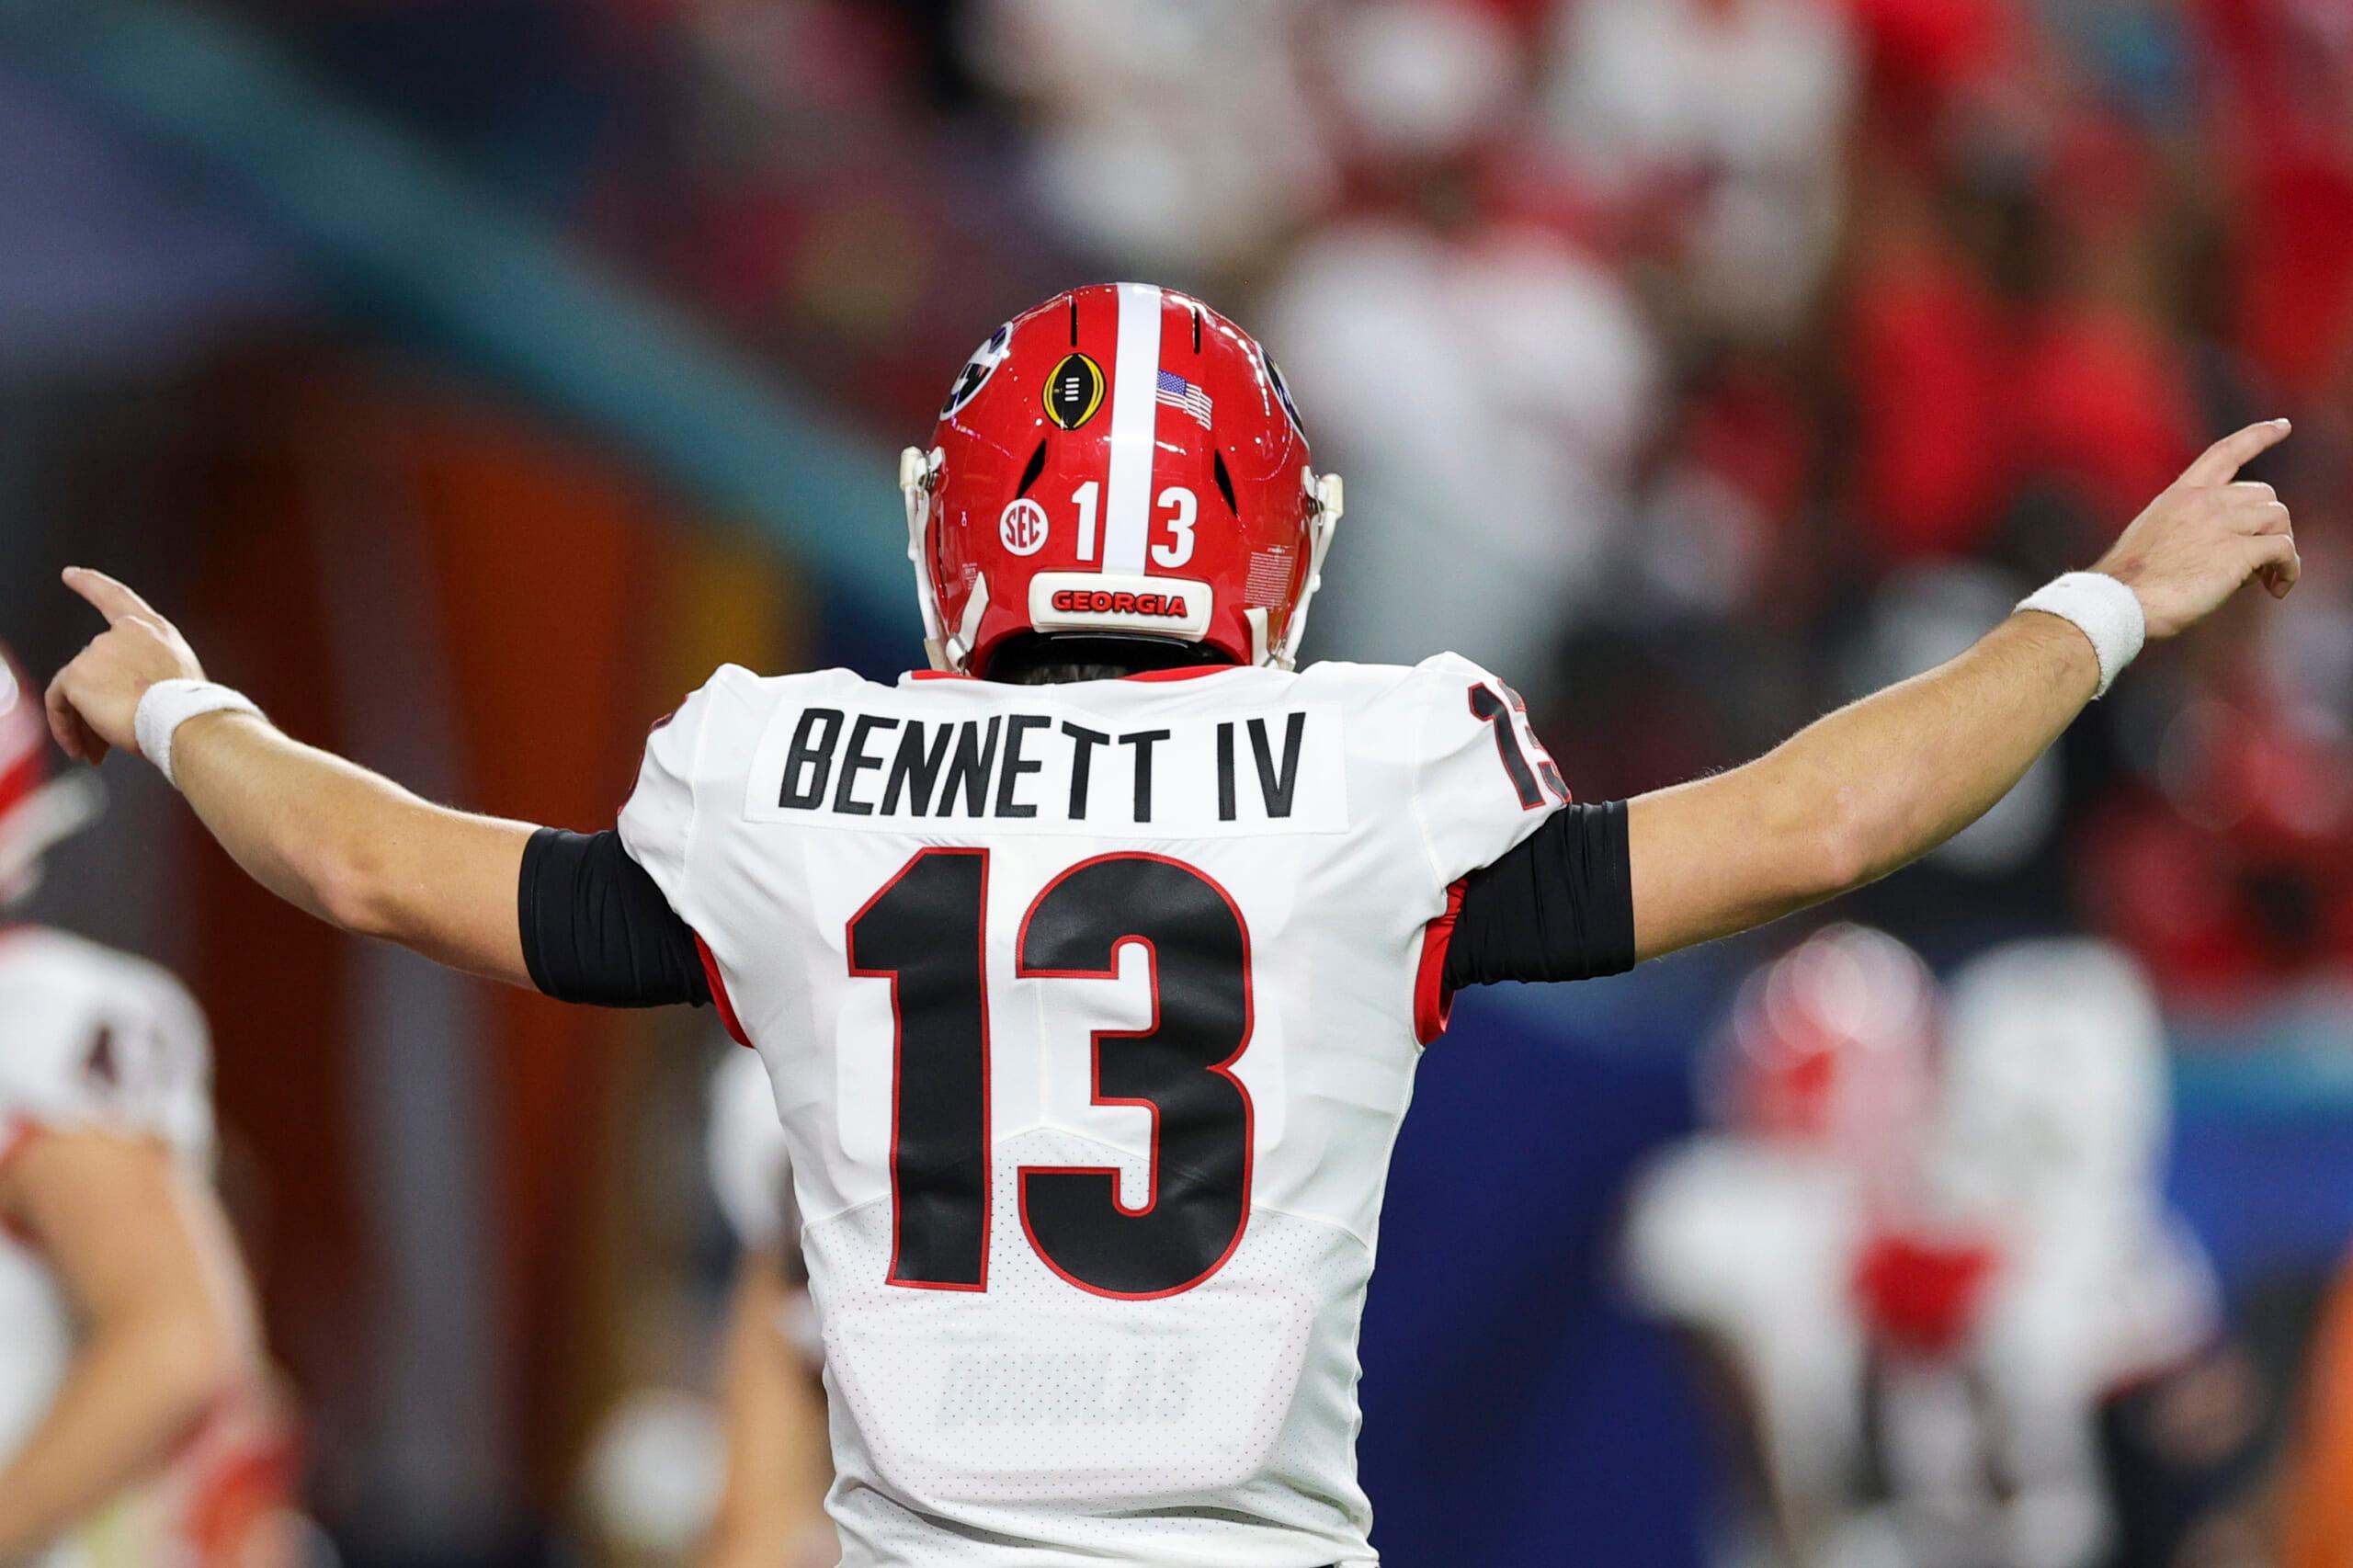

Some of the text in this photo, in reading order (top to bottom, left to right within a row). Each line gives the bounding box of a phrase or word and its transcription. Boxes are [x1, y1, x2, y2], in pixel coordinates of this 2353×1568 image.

[1005, 505, 1041, 549] SEC
[1051, 590, 1188, 618] GEORGIA
[779, 708, 1306, 823] BENNETT IV
[846, 846, 1255, 1301] 13
